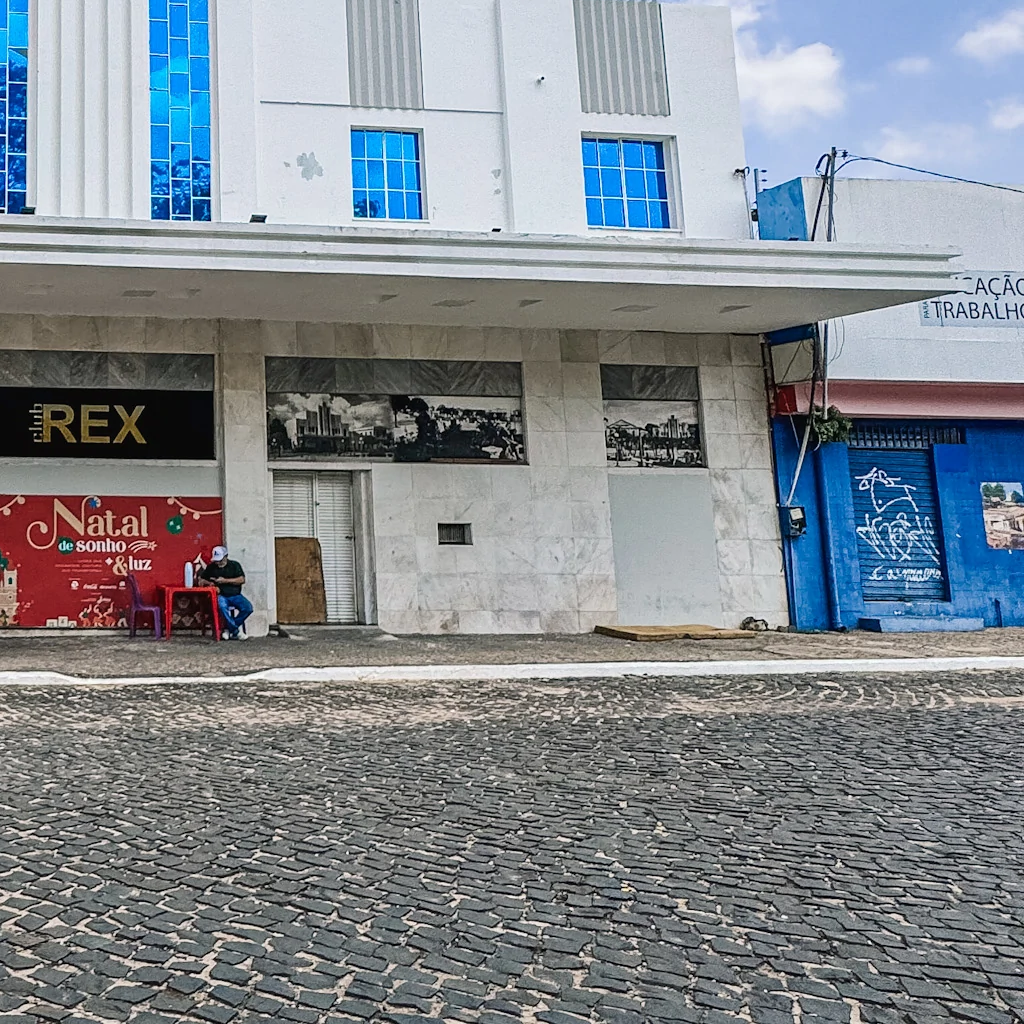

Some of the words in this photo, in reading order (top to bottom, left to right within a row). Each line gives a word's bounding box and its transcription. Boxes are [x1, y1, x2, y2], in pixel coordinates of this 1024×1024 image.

[930, 301, 1024, 320] TRABALH
[29, 403, 43, 443] club
[42, 403, 147, 444] REX
[26, 495, 149, 550] Natal
[58, 540, 74, 551] de
[76, 537, 127, 553] sonho
[112, 555, 129, 576] &
[128, 555, 152, 571] luz
